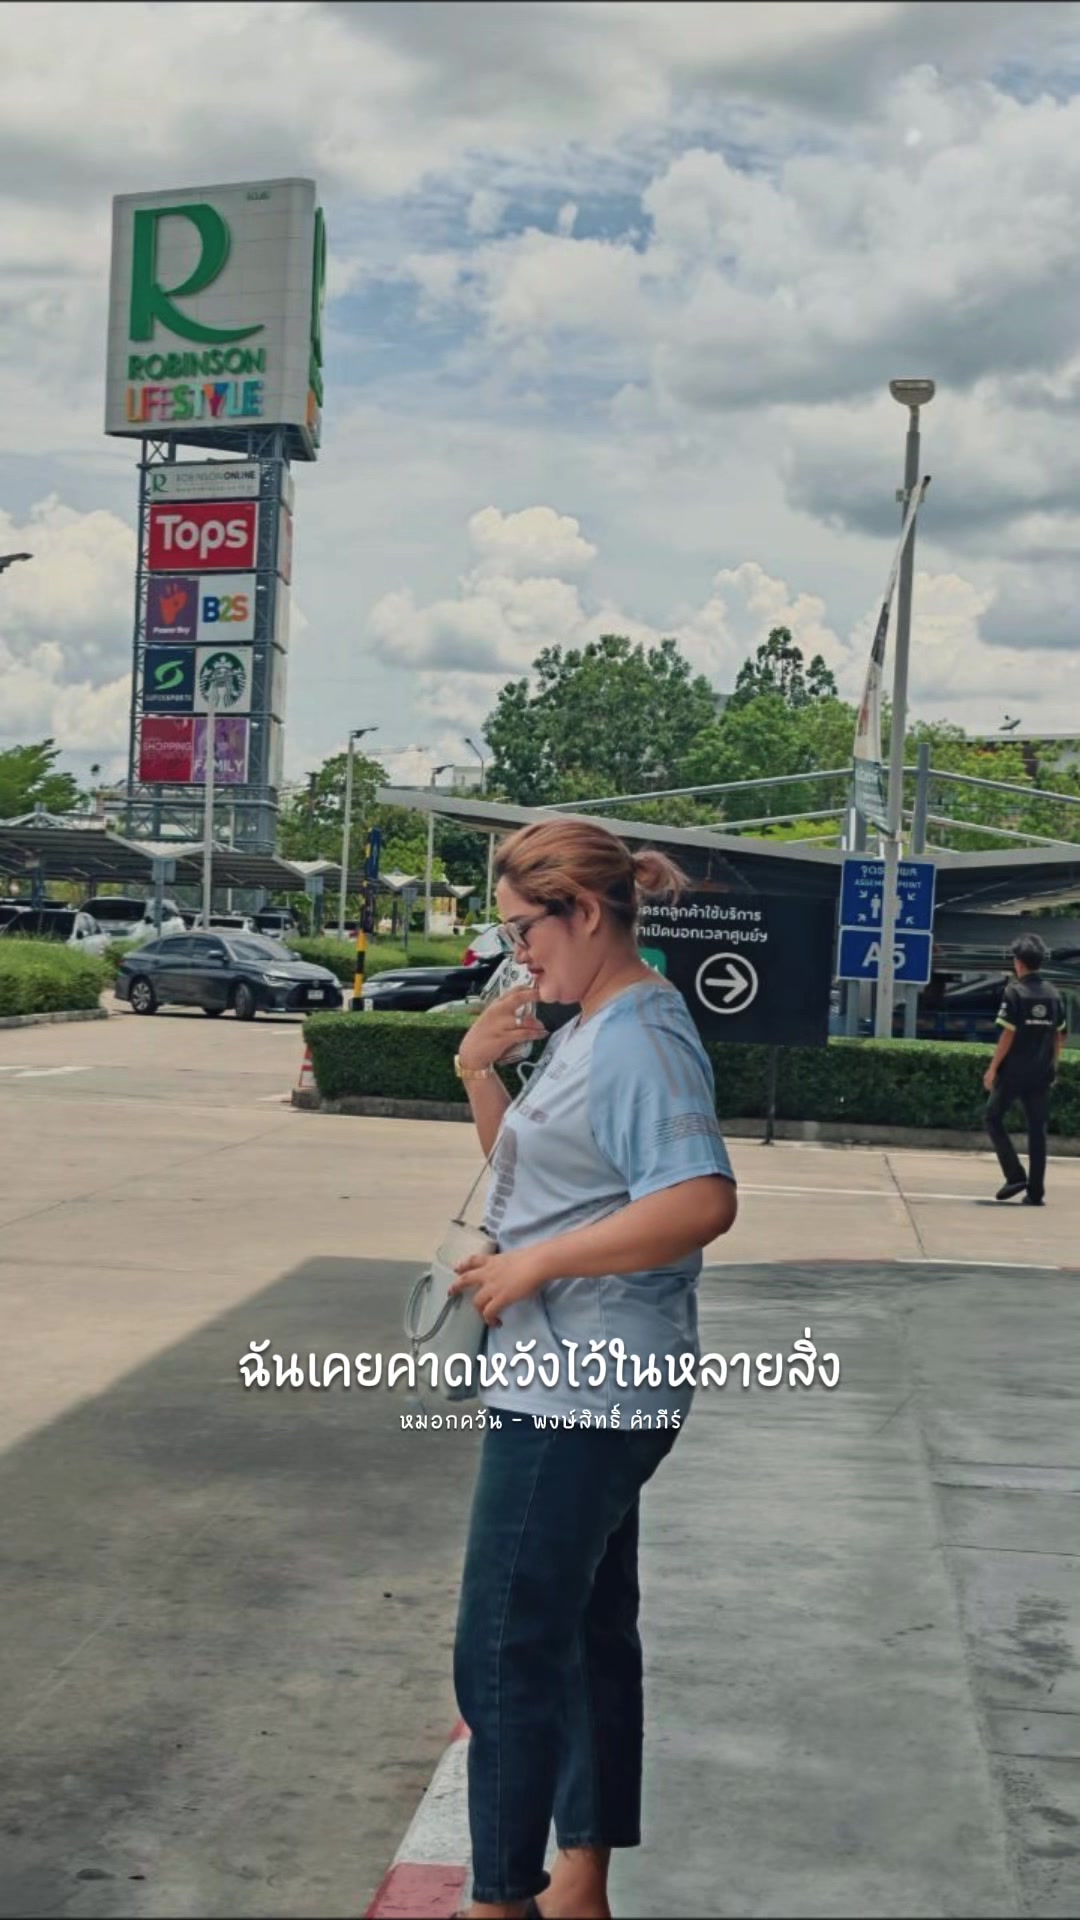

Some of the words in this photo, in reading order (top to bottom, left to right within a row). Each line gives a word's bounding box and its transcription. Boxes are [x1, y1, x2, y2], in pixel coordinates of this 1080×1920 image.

[129, 203, 265, 344] R
[128, 348, 266, 381] ROBINSON
[126, 379, 265, 423] LIFESTYLE
[156, 515, 248, 560] Tops
[202, 594, 249, 623] B2S
[195, 759, 245, 773] FMILY
[862, 942, 906, 970] A5
